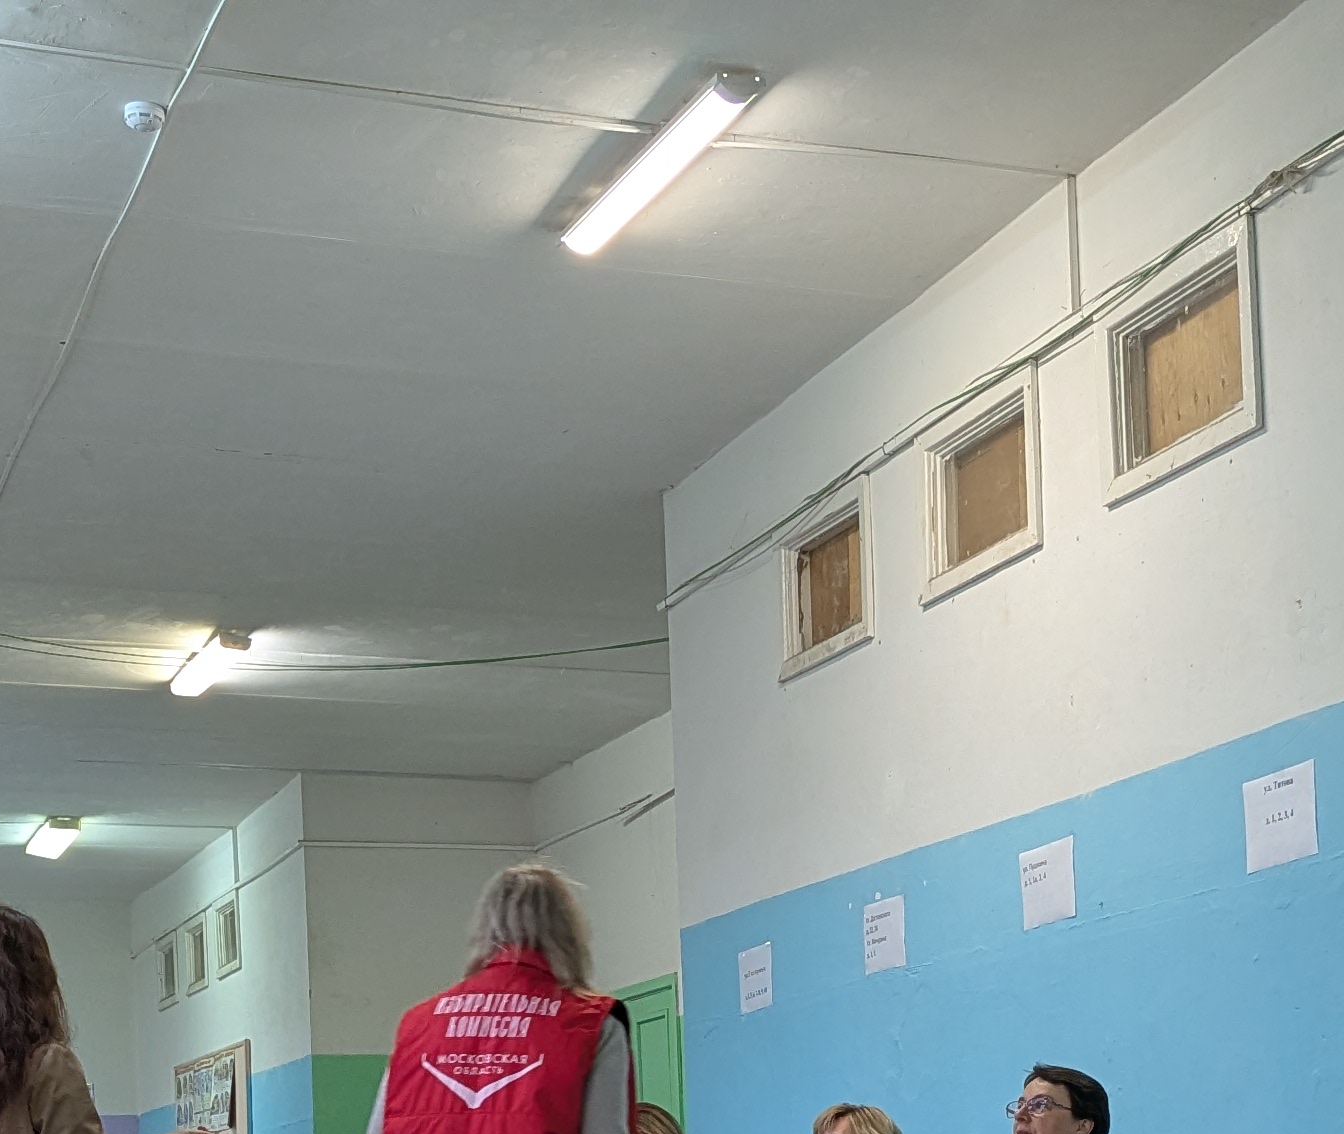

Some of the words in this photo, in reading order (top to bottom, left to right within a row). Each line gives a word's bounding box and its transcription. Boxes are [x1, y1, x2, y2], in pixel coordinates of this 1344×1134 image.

[1273, 778, 1293, 790] Титова
[433, 993, 562, 1017] ИЗБИРАТЕЛЬНАЯ
[444, 1015, 532, 1038] КОМИССИЯ
[436, 1053, 529, 1065] МОСКОВСКАЯ
[452, 1065, 504, 1076] ОБЛАСТЬ
